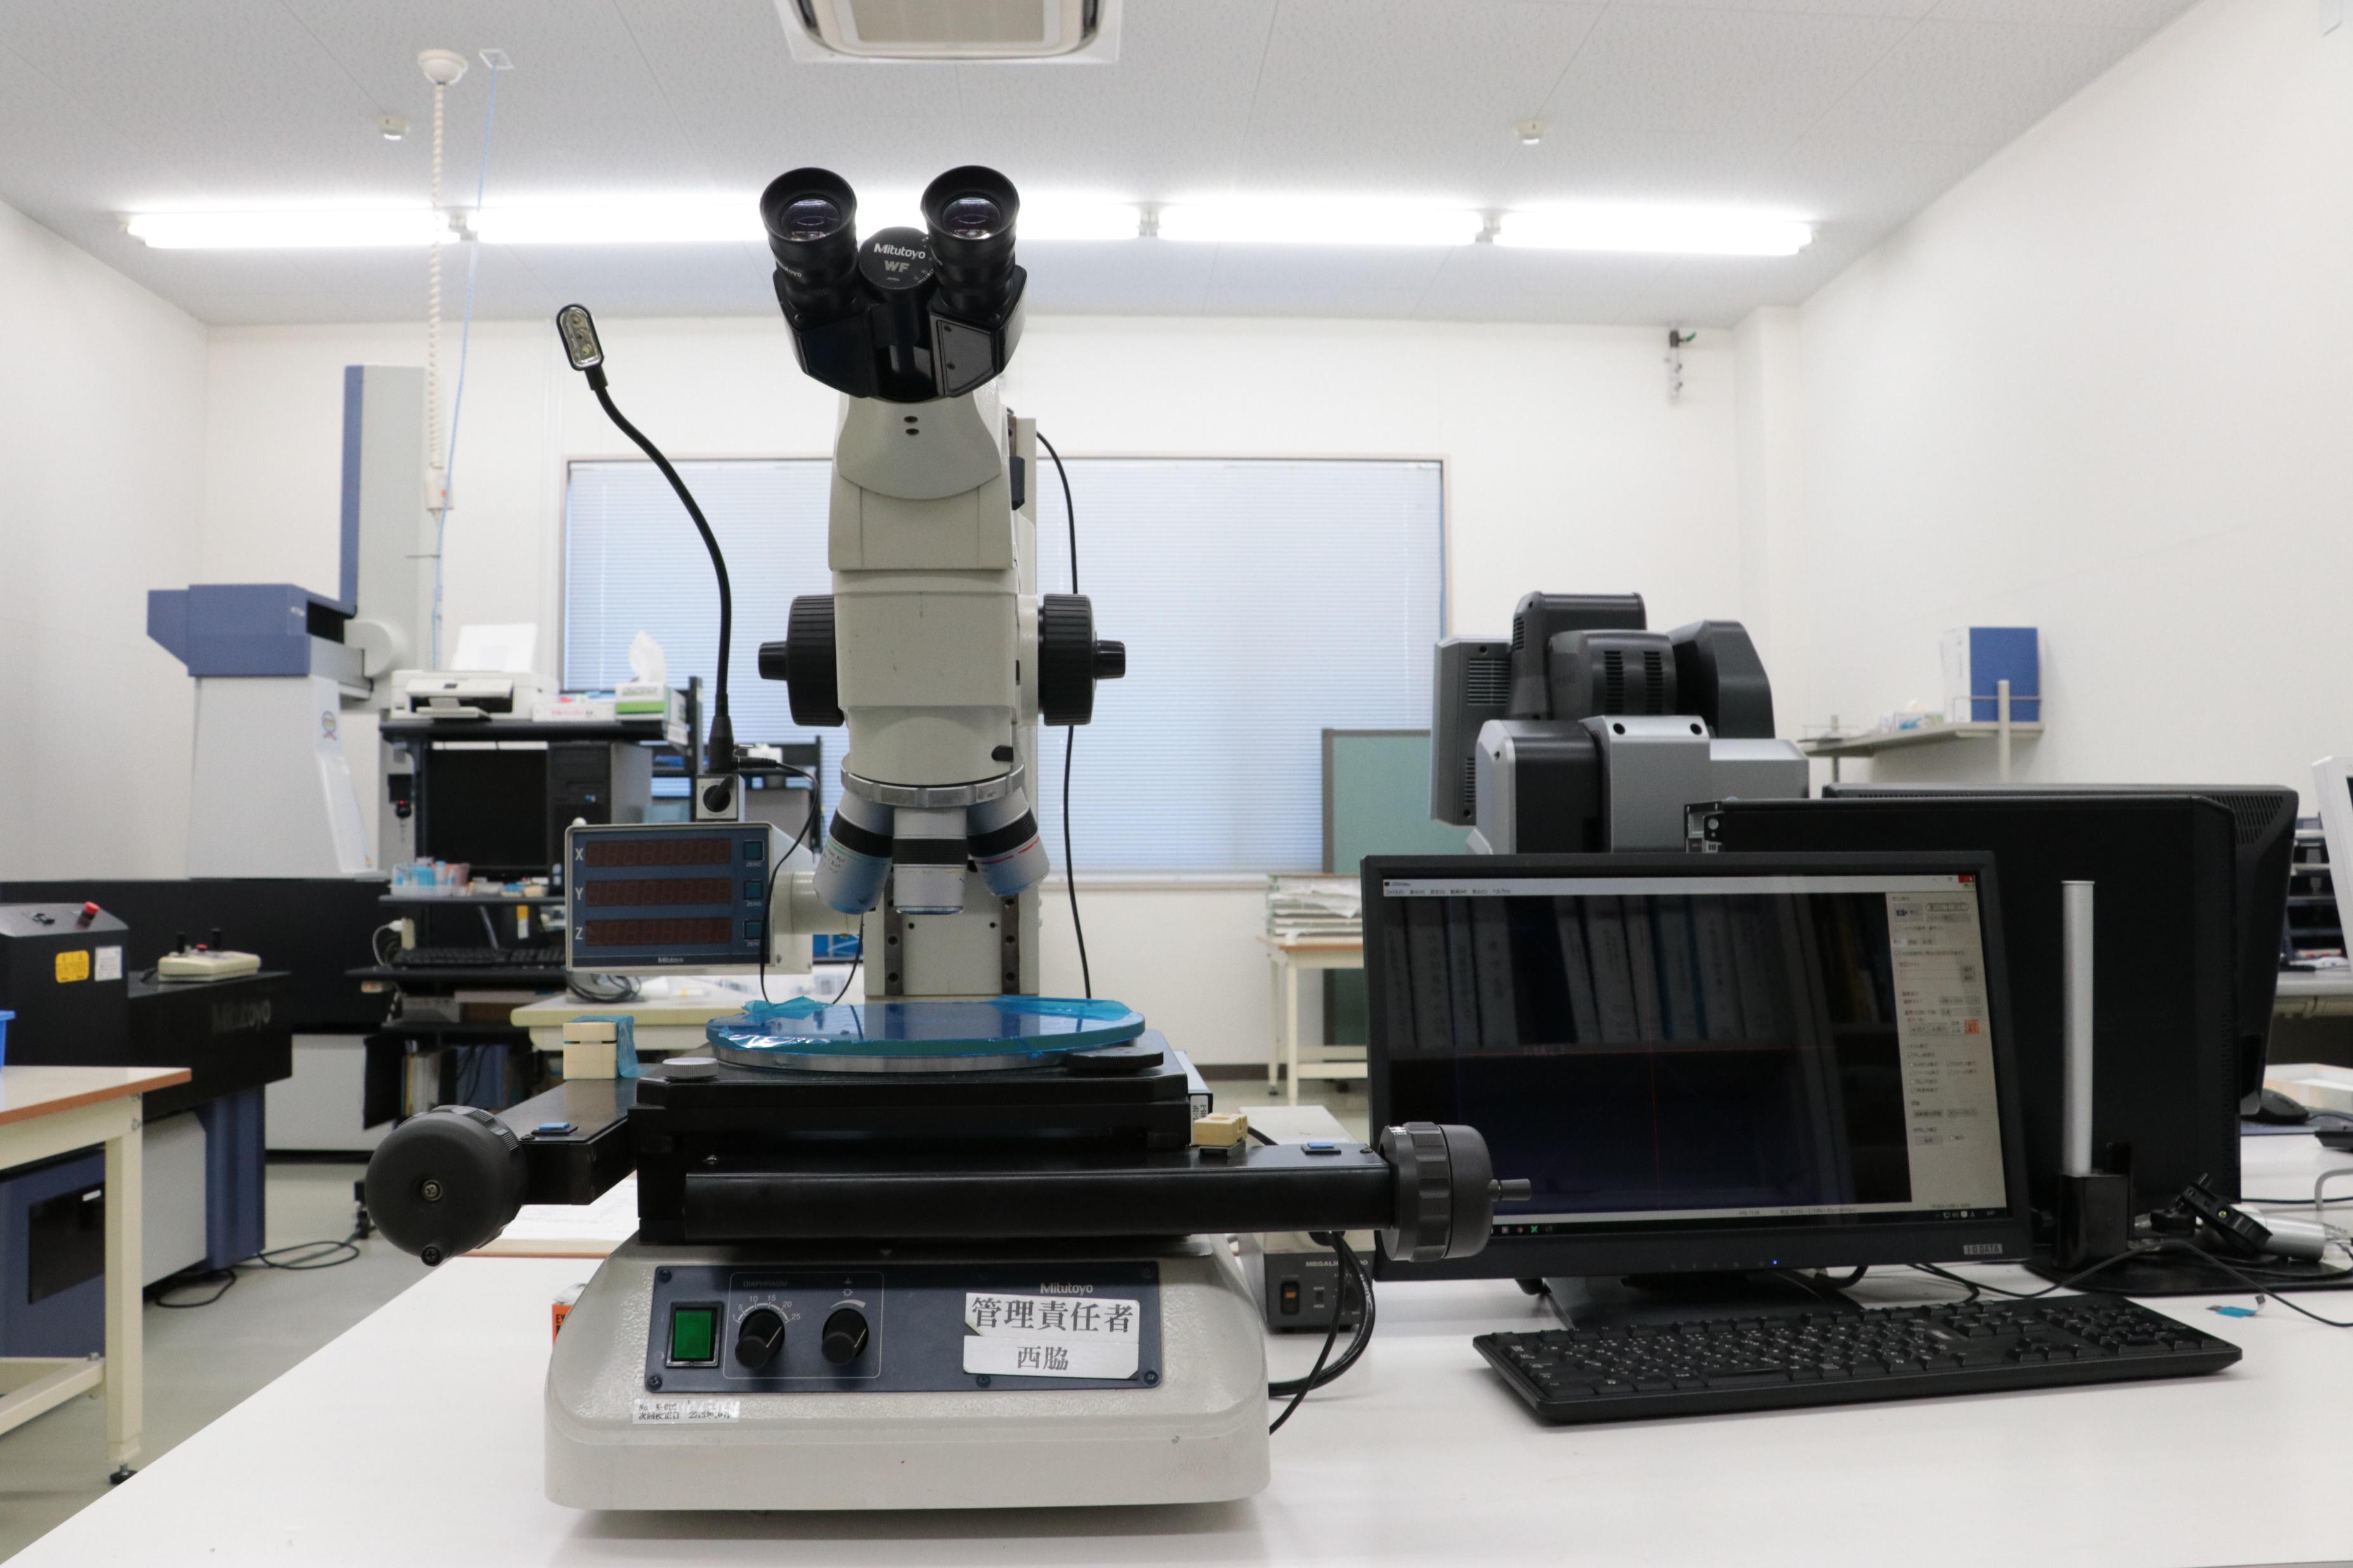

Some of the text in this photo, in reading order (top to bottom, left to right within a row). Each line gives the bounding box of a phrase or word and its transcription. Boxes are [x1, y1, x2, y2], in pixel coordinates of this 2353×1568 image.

[873, 243, 926, 260] Mitutoyo
[884, 260, 910, 273] WF
[575, 848, 583, 861] X
[575, 888, 583, 900] Y
[575, 927, 583, 940] Z
[1039, 1283, 1093, 1296] Mitutoyo
[971, 1296, 1134, 1334] 管理責任者
[1017, 1346, 1069, 1370] 西脇
